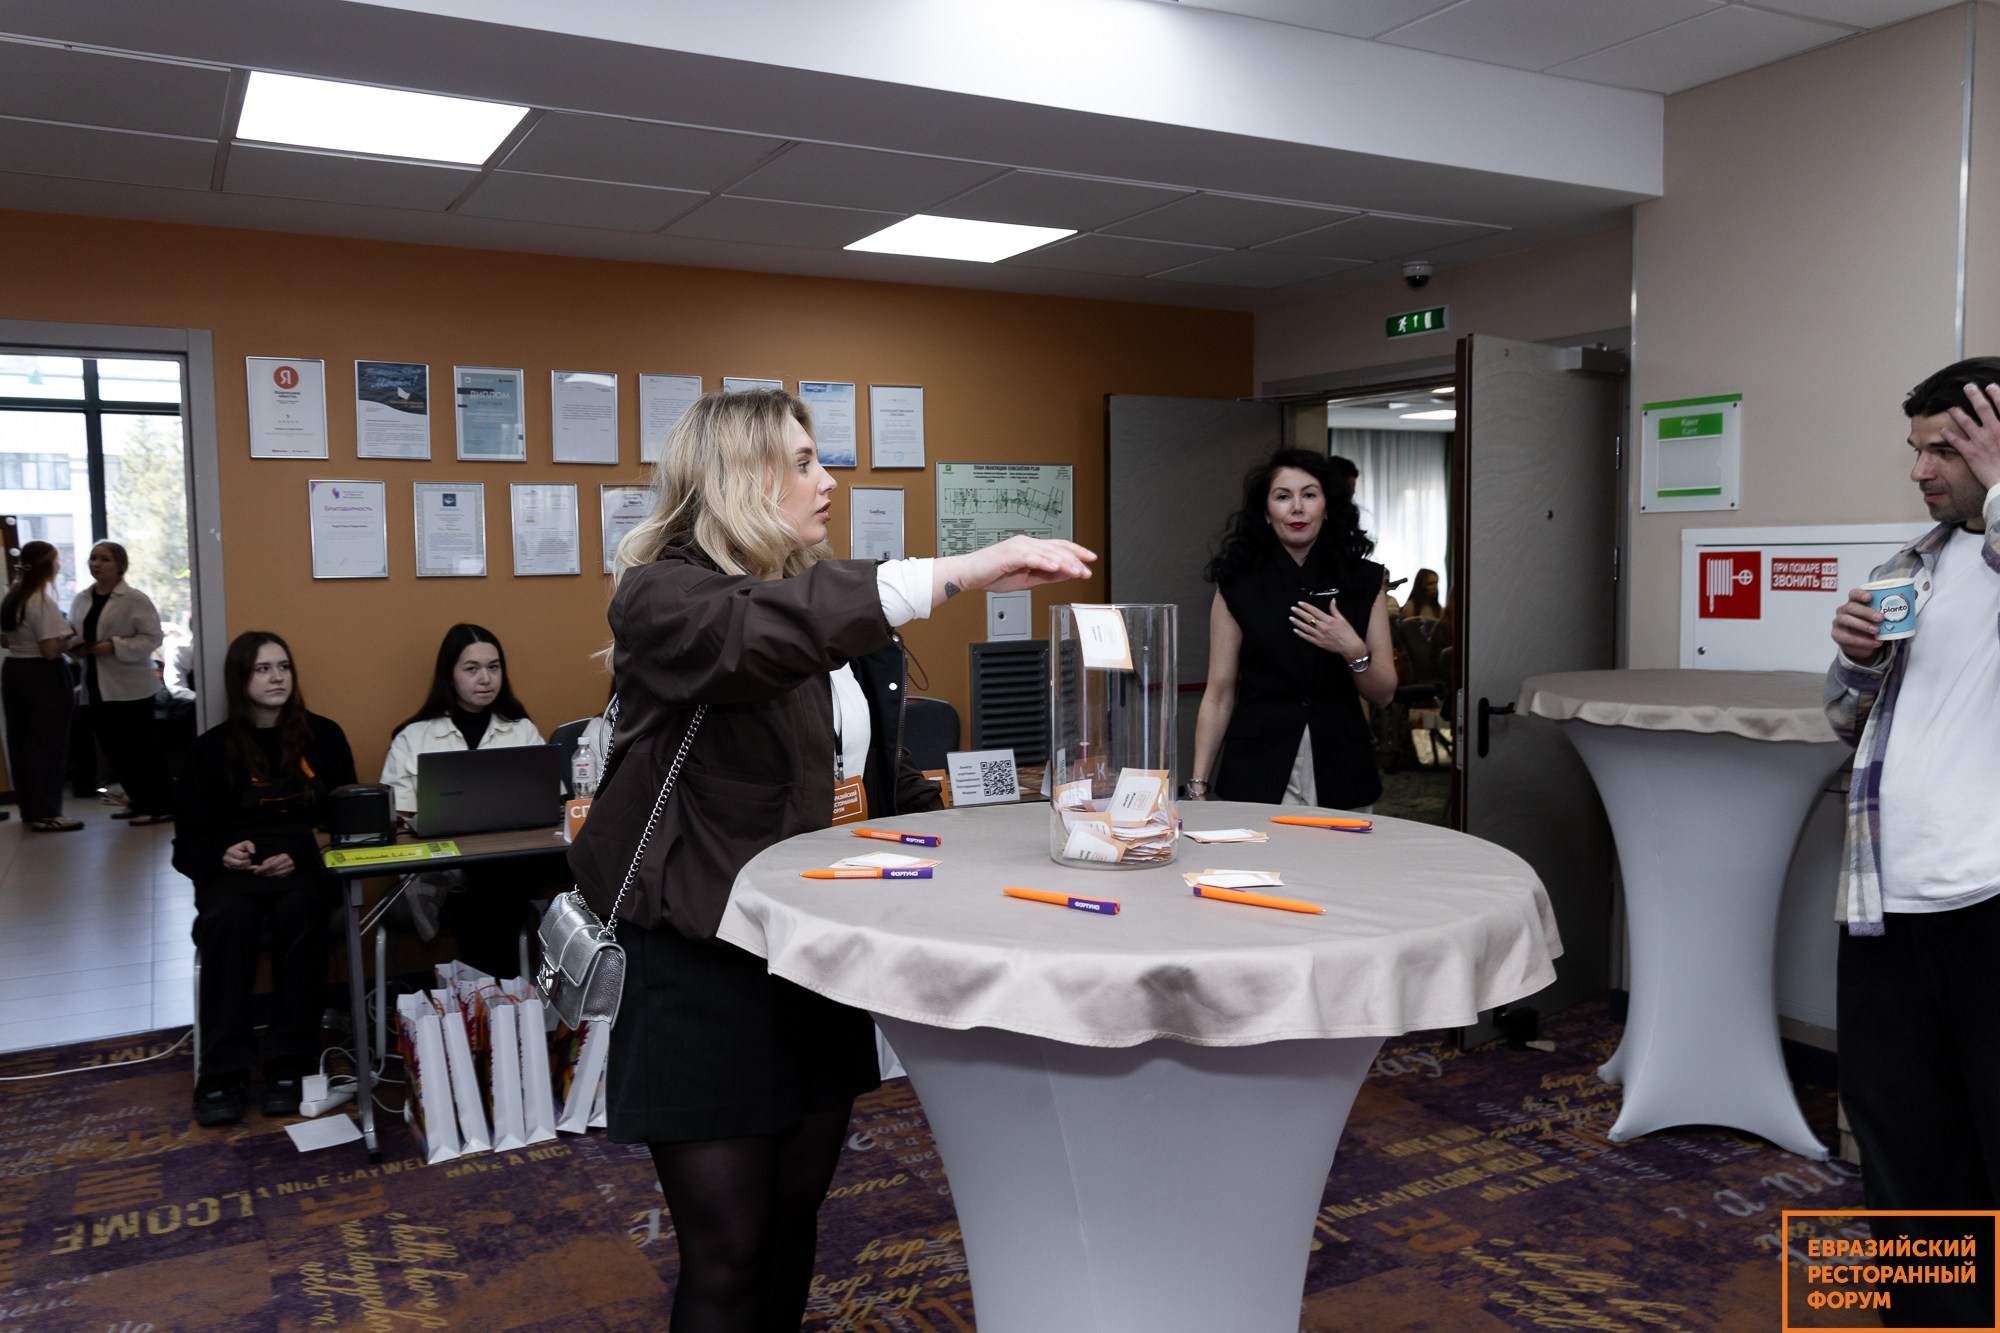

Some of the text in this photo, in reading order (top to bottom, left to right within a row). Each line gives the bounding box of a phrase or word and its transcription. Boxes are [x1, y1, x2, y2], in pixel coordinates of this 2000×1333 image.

[469, 390, 511, 400] ДИПЛОМ
[1773, 563, 1837, 574] ПРИ ПОЖАРЕ 101
[1772, 574, 1836, 588] ЗВОНИТЬ 112
[1882, 605, 1908, 615] planto
